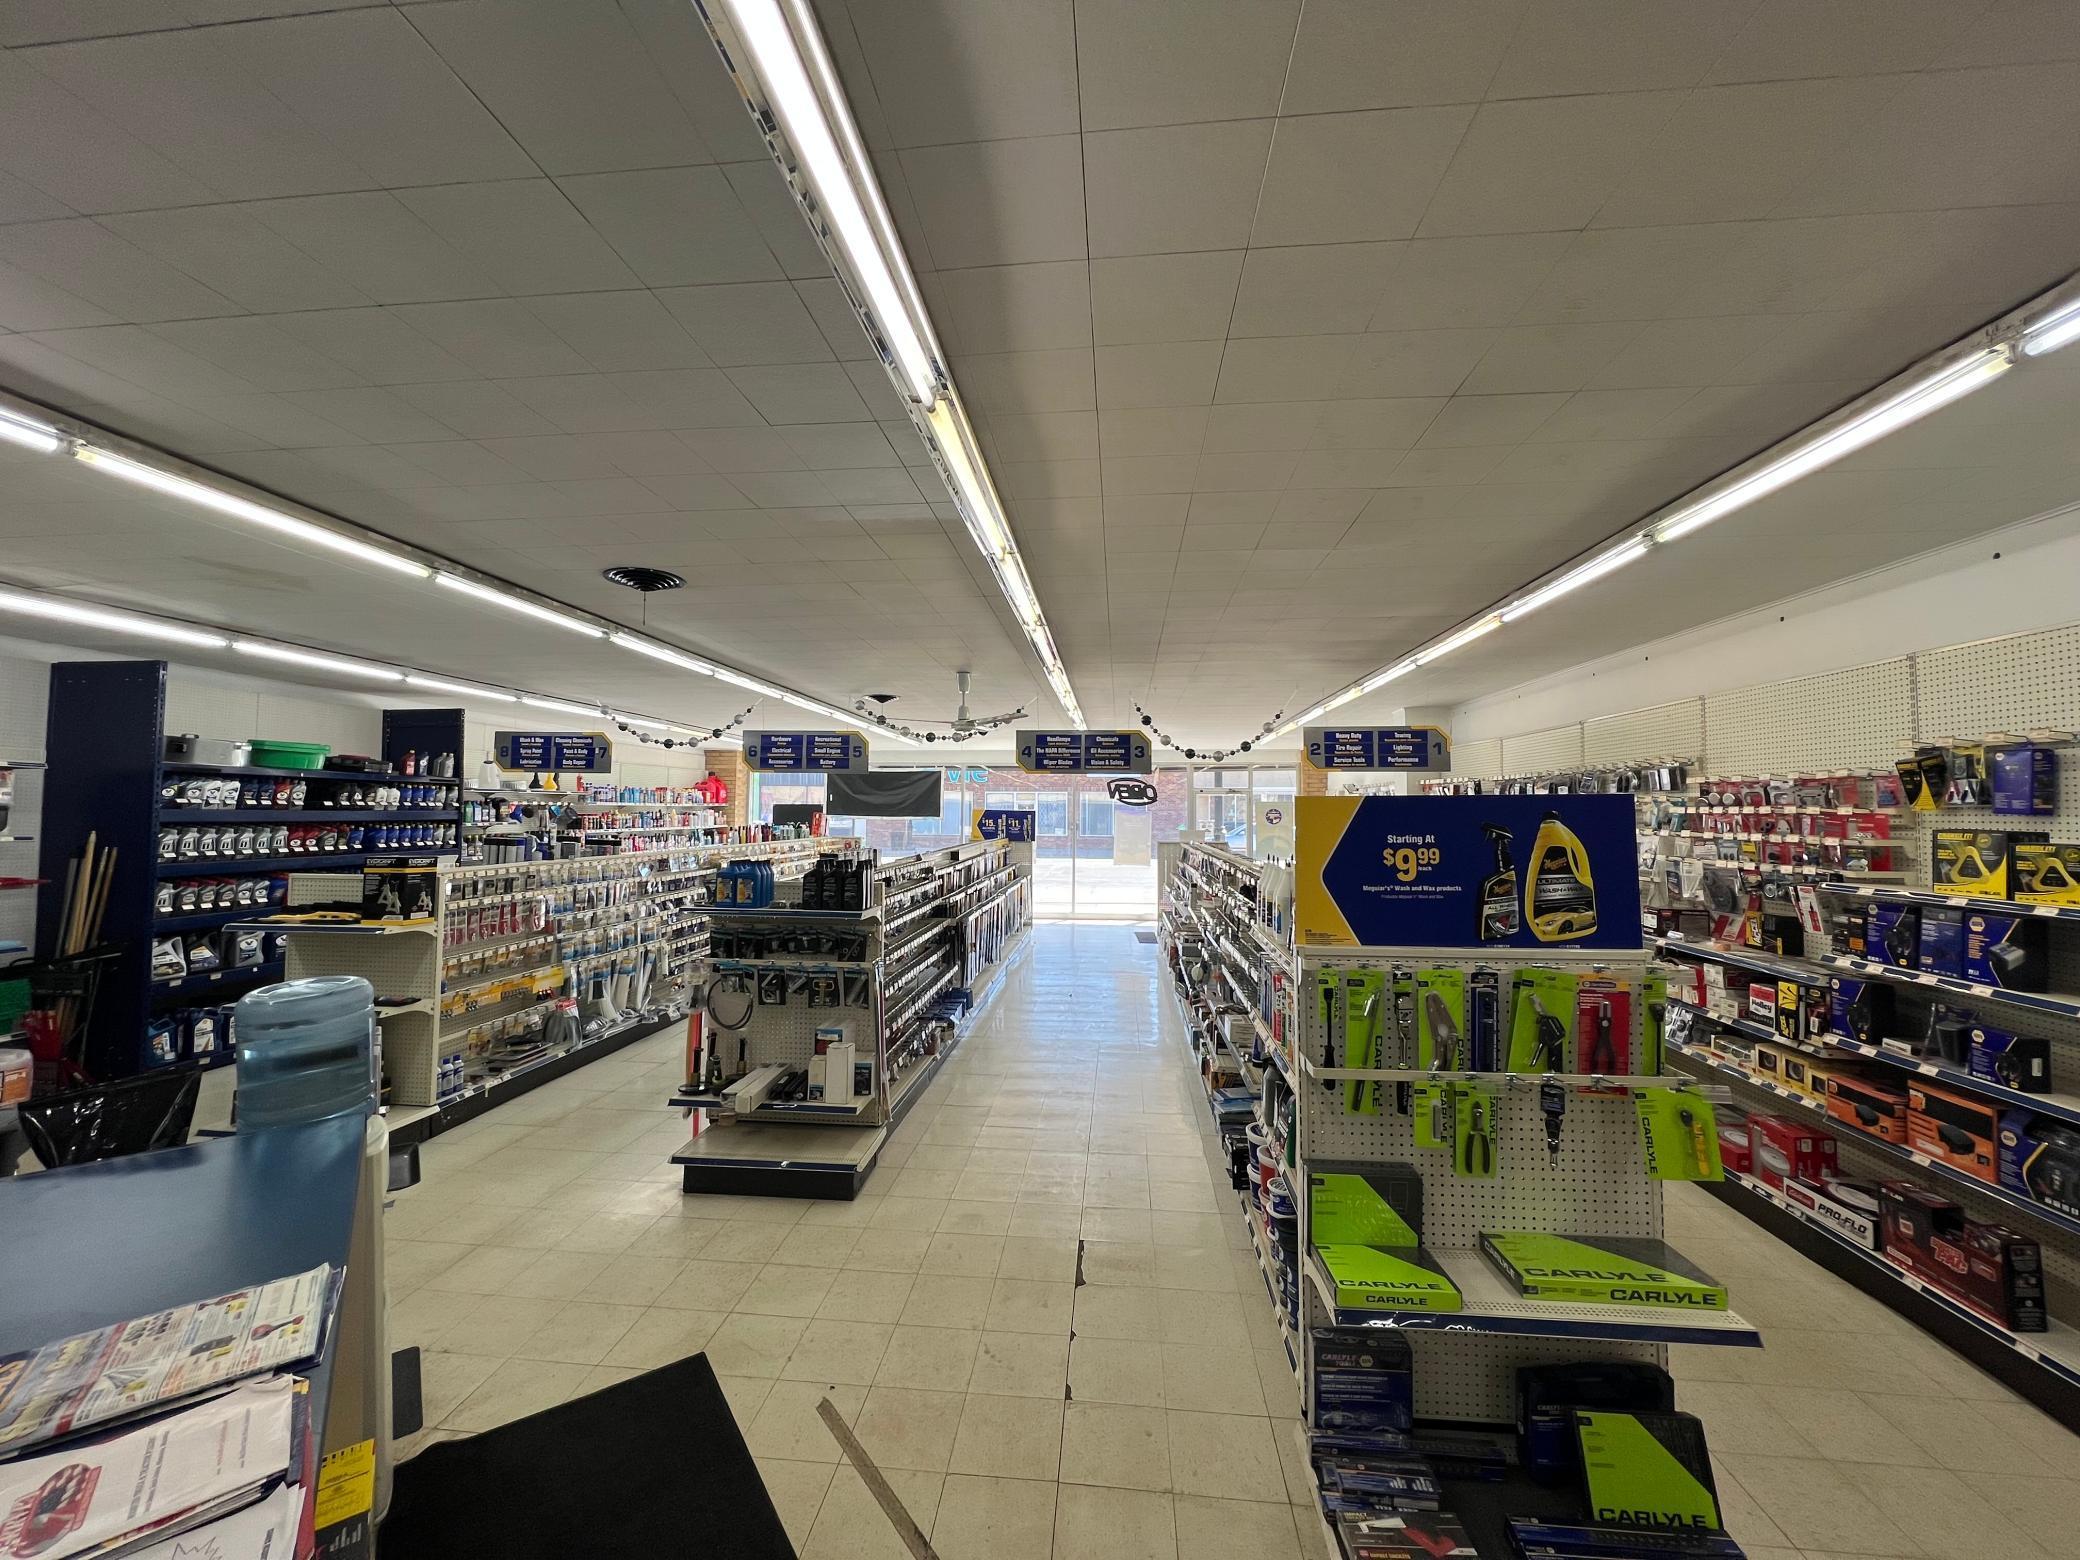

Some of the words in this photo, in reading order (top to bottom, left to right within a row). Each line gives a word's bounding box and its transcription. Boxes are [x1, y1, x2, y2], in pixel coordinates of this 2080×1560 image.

[599, 747, 608, 759] 7
[748, 745, 758, 757] 6
[852, 746, 863, 757] 5
[1021, 745, 1033, 758] 4
[1134, 745, 1145, 758] 3
[1310, 743, 1322, 755] 2
[1393, 744, 1413, 752] Lighting
[1432, 742, 1442, 755] 1
[1387, 834, 1423, 845] Starting
[1424, 834, 1435, 843] At
[1751, 998, 1772, 1014] Holley
[1641, 1117, 1658, 1174] CARLYLE
[1817, 1203, 1868, 1234] PRO-FLO
[1484, 1240, 1516, 1280] CARLYLE
[1523, 1268, 1669, 1283] CARLYLE
[1338, 1279, 1442, 1290] CARLYLE
[1365, 1295, 1428, 1306] CARLYLE
[1609, 1288, 1718, 1306] CARLYLE
[1599, 1508, 1706, 1527] CARLYLE
